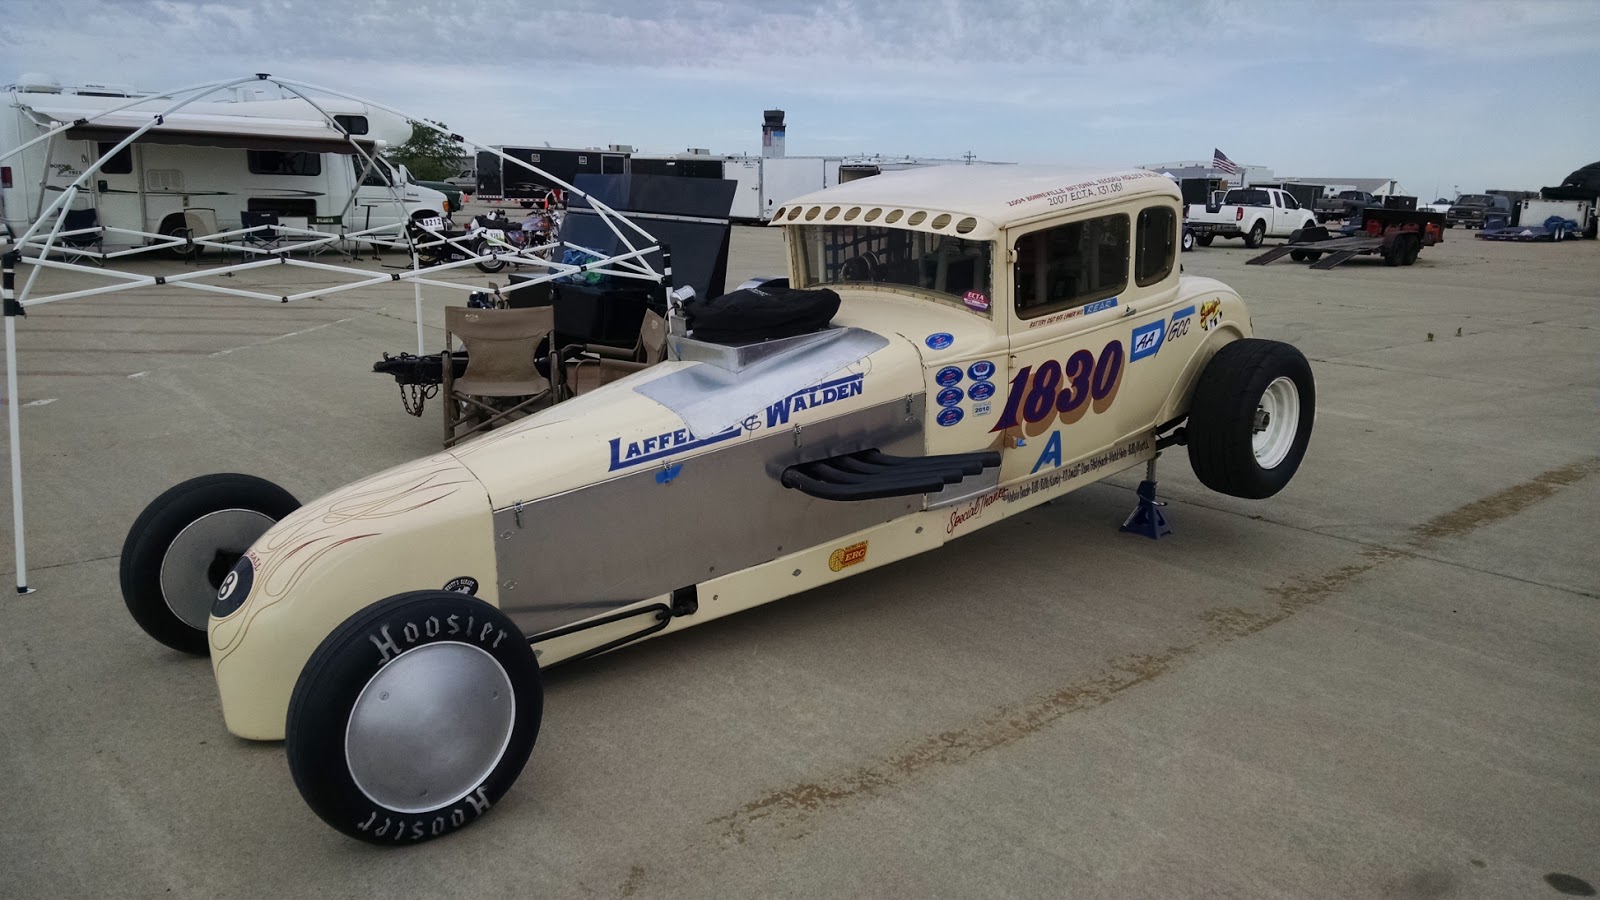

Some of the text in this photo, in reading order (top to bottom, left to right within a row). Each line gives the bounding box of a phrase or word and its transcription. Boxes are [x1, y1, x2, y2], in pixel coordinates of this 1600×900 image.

[1026, 188, 1066, 201] BONNEVILLE
[1065, 181, 1098, 192] NATIONAL
[1047, 194, 1068, 206] 2007
[1097, 182, 1123, 195] 131.061
[967, 291, 985, 301] ECTA
[1086, 301, 1111, 314] REAR
[1135, 331, 1156, 351] AA
[988, 340, 1123, 434] 1830
[974, 405, 990, 414] 2010
[608, 426, 742, 472] LAFFE
[766, 374, 864, 429] WALDEN
[1030, 430, 1062, 475] A
[946, 497, 981, 537] Special
[845, 549, 866, 562] ERC
[219, 571, 237, 599] 8
[368, 614, 508, 666] Hoosier
[357, 785, 492, 841] Hoosier
